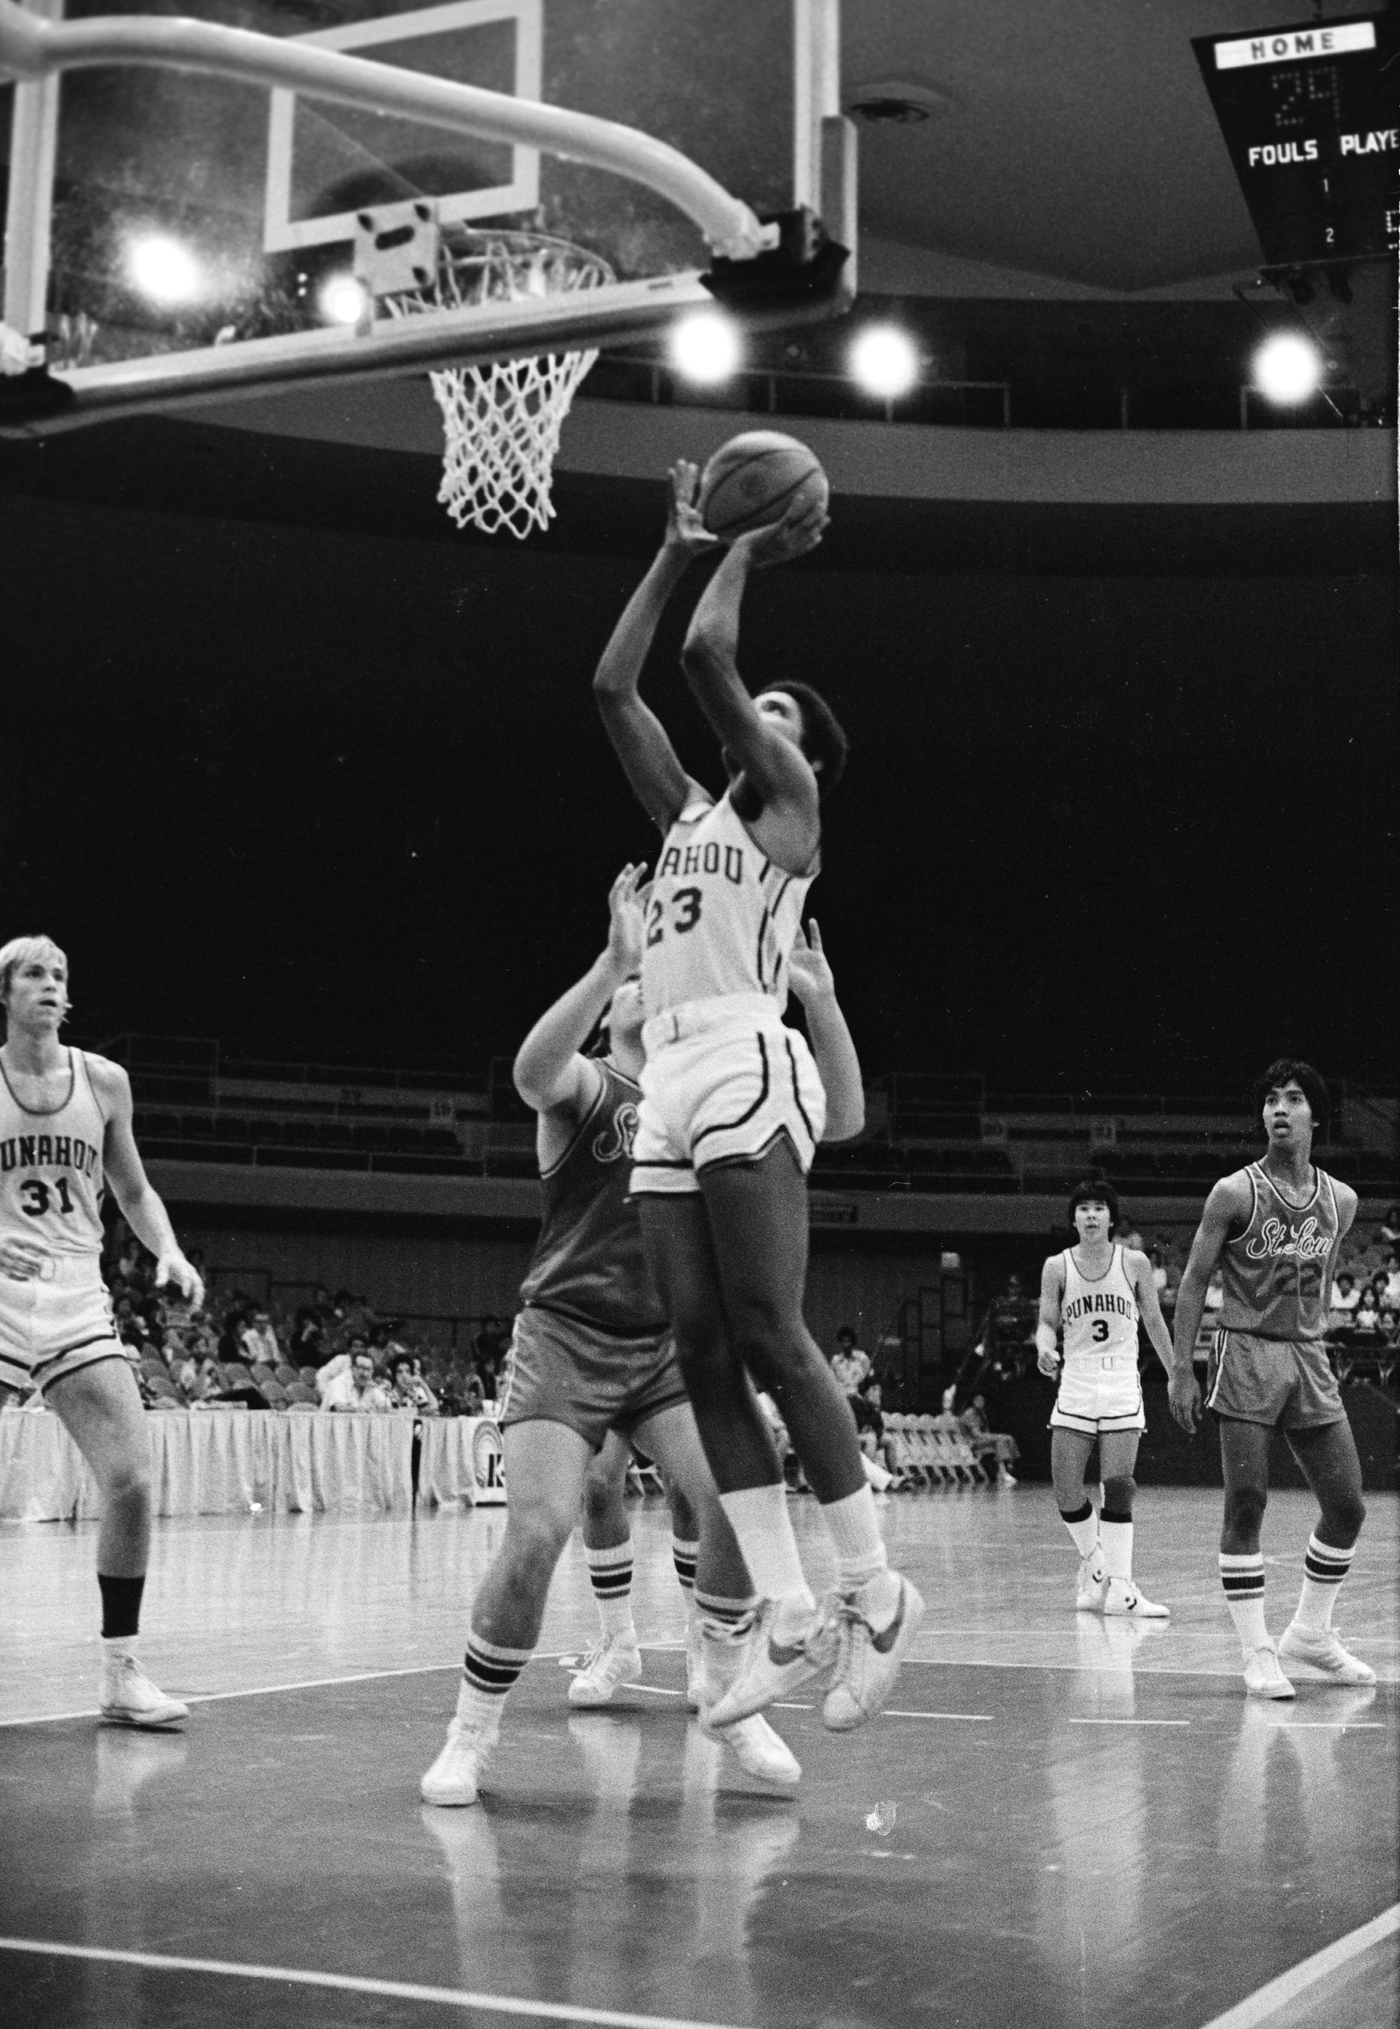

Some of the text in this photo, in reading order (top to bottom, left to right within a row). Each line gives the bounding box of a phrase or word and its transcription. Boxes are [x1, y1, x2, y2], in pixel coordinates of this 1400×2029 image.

[1251, 31, 1335, 61] HOME
[1249, 139, 1318, 167] FOULS
[1325, 227, 1335, 243] 2
[646, 886, 702, 948] 23
[20, 1177, 74, 1217] 31
[1274, 1261, 1322, 1297] 22
[1066, 1294, 1132, 1326] PUNAHOU
[1091, 1319, 1109, 1343] 3
